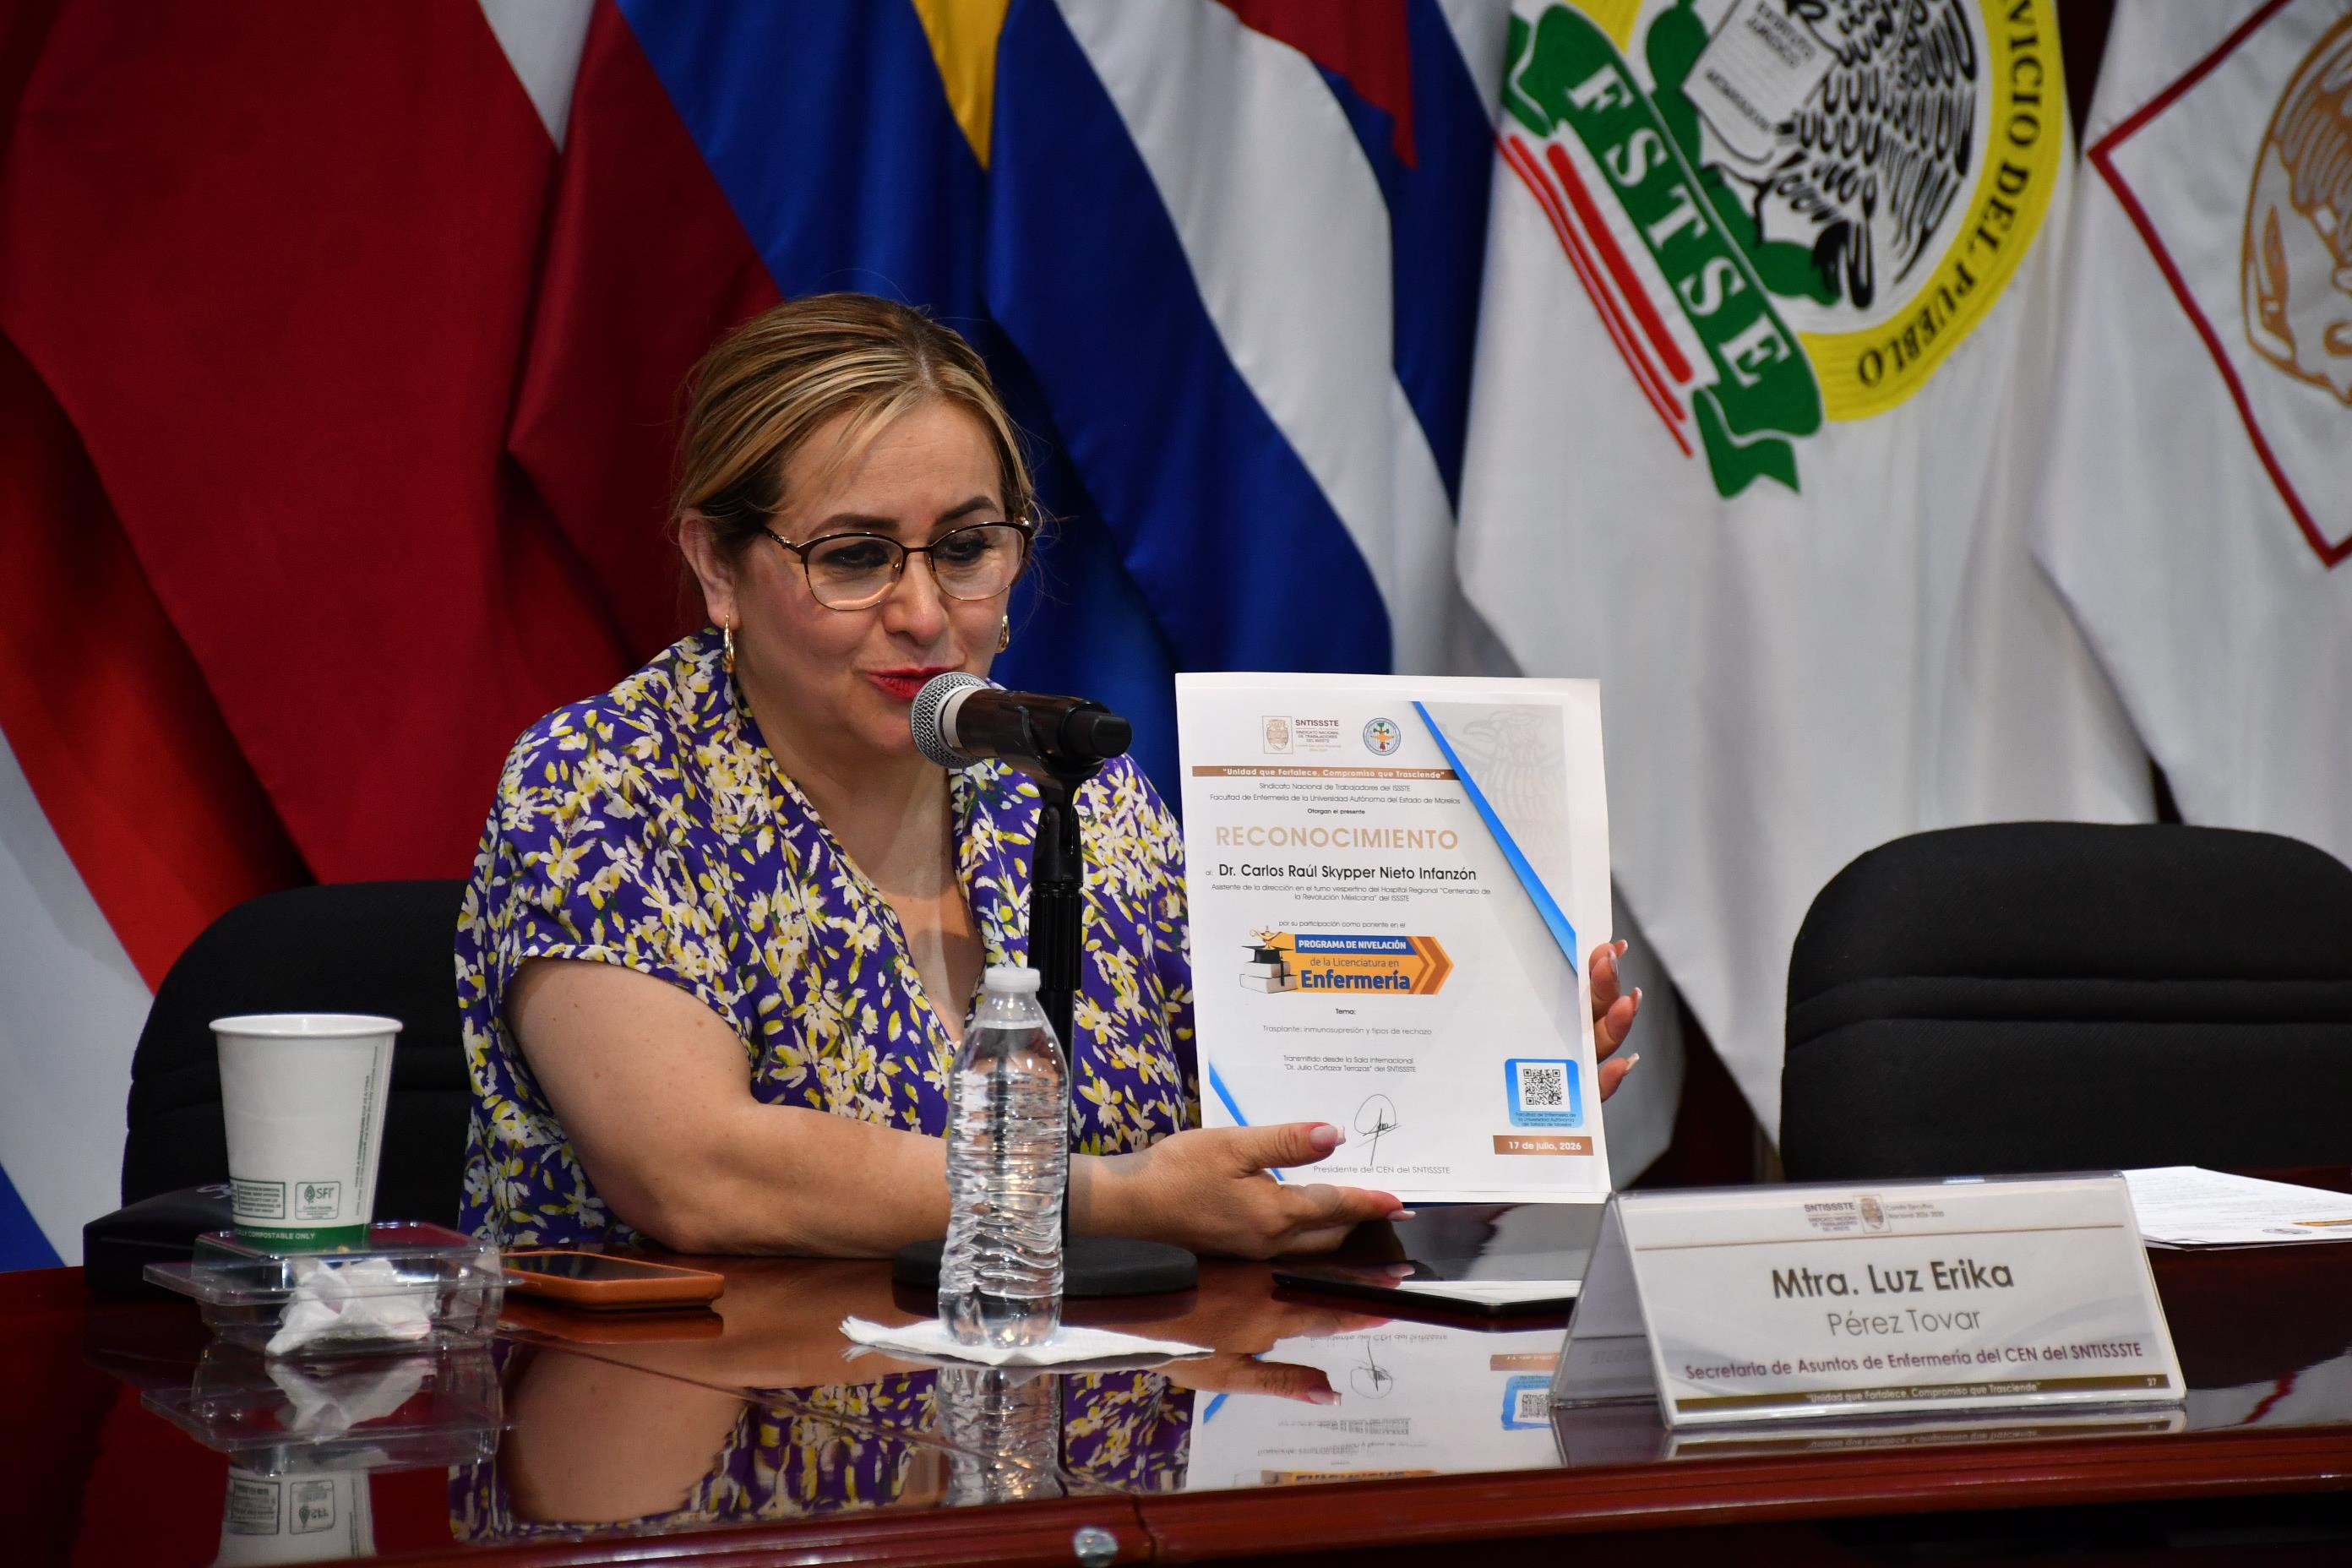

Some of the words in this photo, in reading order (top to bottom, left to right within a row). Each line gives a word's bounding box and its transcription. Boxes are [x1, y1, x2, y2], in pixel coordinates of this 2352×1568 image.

[1970, 161, 2029, 253] DEL
[1567, 63, 1791, 388] FSTSE
[1859, 260, 1975, 387] PUEBLO
[1322, 770, 1375, 778] Compromiso
[1210, 792, 1240, 801] Facultad
[1253, 793, 1288, 802] Enfermería
[1309, 794, 1348, 803] Universidad
[1386, 795, 1397, 803] del
[1434, 796, 1460, 804] Morelos
[1216, 825, 1459, 850] RECONOCIMIENTO
[1219, 863, 1235, 875] Dr.
[1241, 863, 1283, 876] Carlos
[1288, 864, 1316, 877] Raúl
[1321, 865, 1375, 880] Skypper
[1380, 866, 1414, 879] Nieto
[1419, 867, 1476, 879] Infanzón
[1298, 939, 1345, 949] PROGRAMA
[1346, 940, 1357, 949] DE
[1358, 939, 1406, 950] NIVELACIÓN
[1333, 958, 1386, 966] Licenciatura
[1301, 969, 1410, 989] Enfermería
[1361, 1164, 1374, 1173] del
[1804, 1202, 1855, 1213] SNTISSSTE
[1772, 1267, 1859, 1298] Mtra.
[1867, 1264, 1924, 1294] Luz
[1930, 1259, 2014, 1291] Erika
[1827, 1310, 1903, 1337] Pérez
[1906, 1309, 1980, 1332] Tovar
[1685, 1363, 1768, 1379] Secretaria
[1772, 1361, 1793, 1377] de
[1798, 1357, 1858, 1372] Asuntos
[1862, 1355, 1883, 1369] de
[1886, 1349, 1972, 1367] Enfermería
[1975, 1348, 2001, 1364] del
[2004, 1347, 2038, 1362] CEN
[2042, 1346, 2067, 1360] del
[2072, 1342, 2142, 1358] SNTISSSTE
[1845, 1393, 1863, 1402] que
[1912, 1386, 1968, 1398] Compromiso
[1970, 1386, 1987, 1396] que
